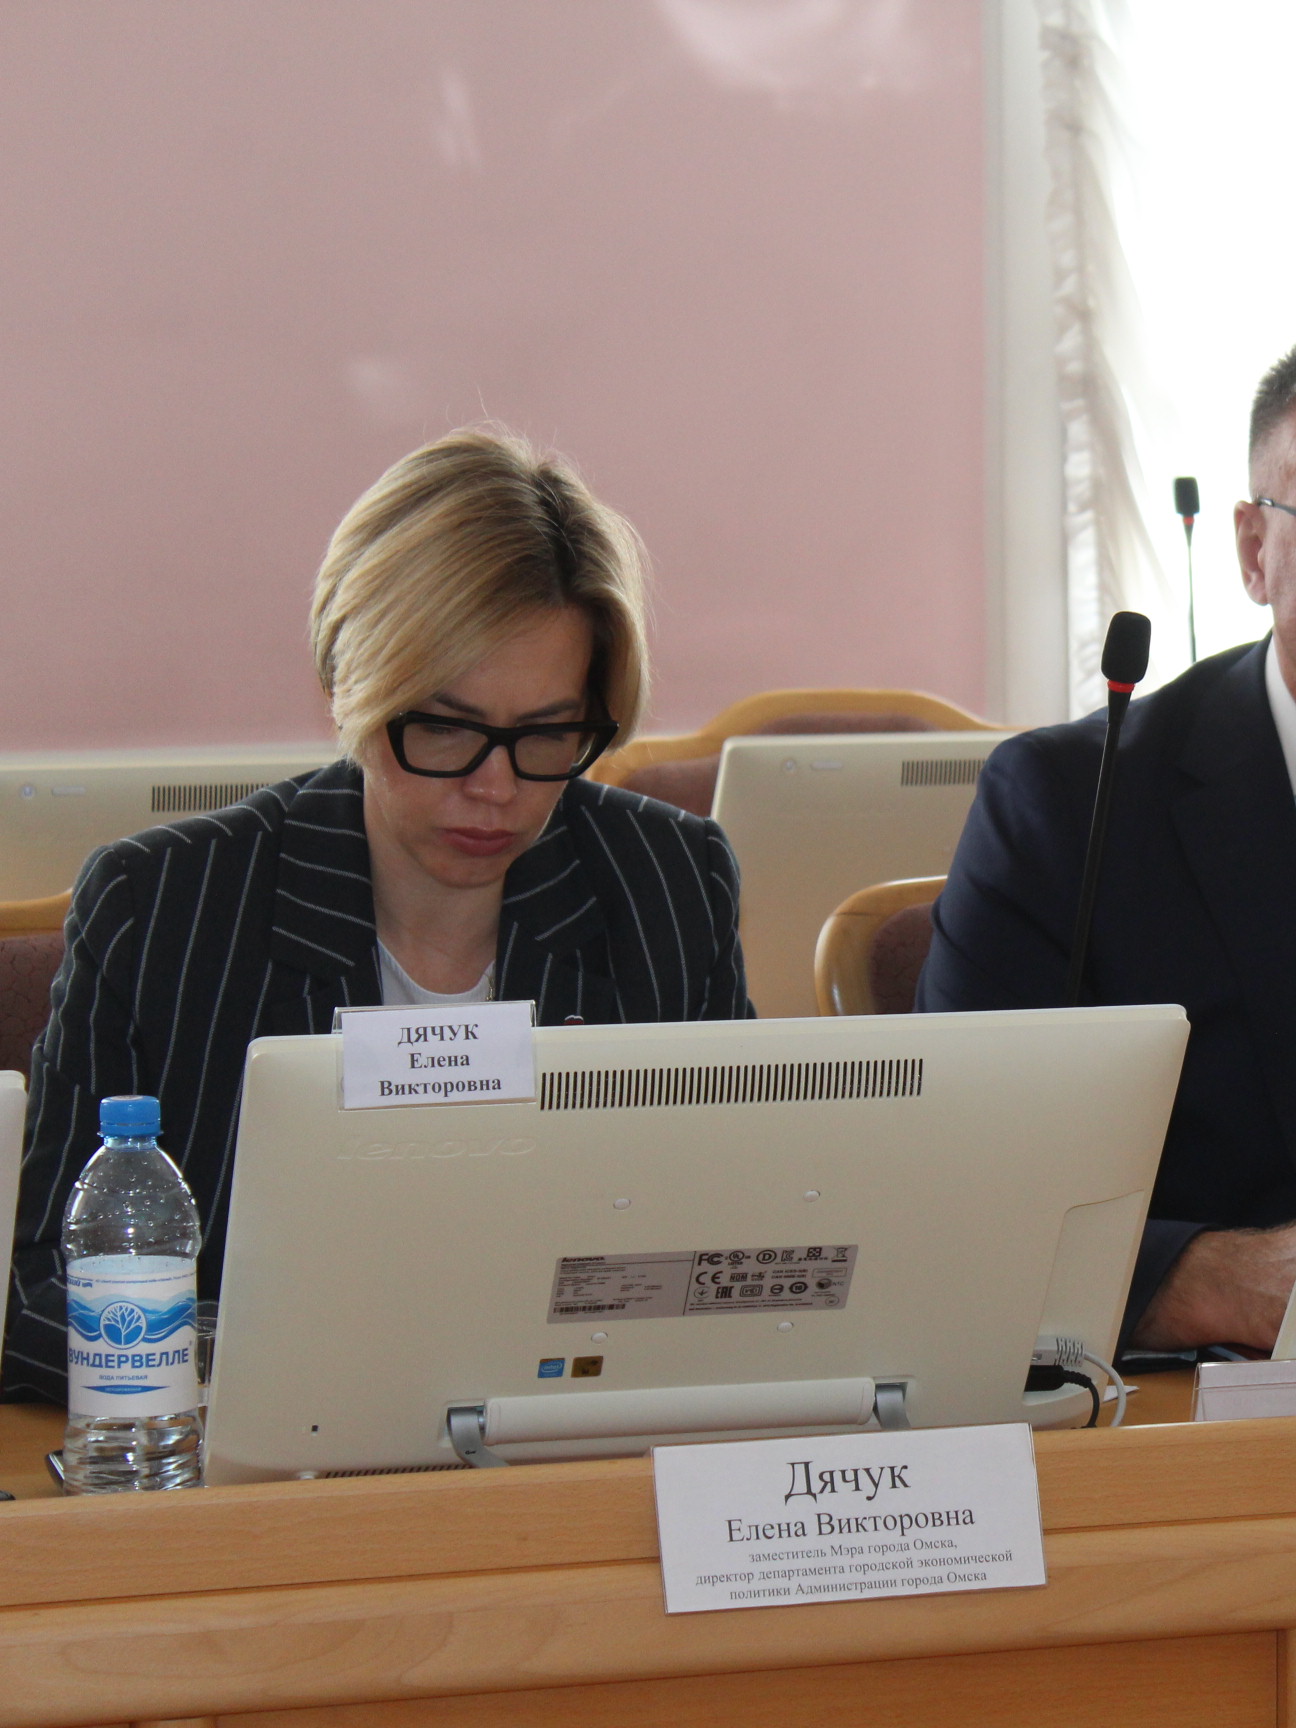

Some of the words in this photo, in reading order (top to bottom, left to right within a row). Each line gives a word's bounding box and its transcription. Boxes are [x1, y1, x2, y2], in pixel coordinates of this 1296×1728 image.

[397, 1023, 479, 1047] ДЯЧУК
[409, 1052, 470, 1069] Елена
[378, 1077, 502, 1097] Викторовна
[336, 1136, 536, 1160] lenovo
[68, 1348, 189, 1369] ВУНДЕРВЕЛЛЕ
[784, 1460, 911, 1505] Дячук
[725, 1517, 807, 1543] Елена
[815, 1508, 976, 1537] Викторовна
[749, 1548, 827, 1563] заместитель
[830, 1544, 864, 1558] Мэра
[868, 1542, 910, 1556] города
[913, 1538, 958, 1550] Омска,
[696, 1571, 754, 1586] директор
[758, 1565, 845, 1581] департамента
[849, 1557, 913, 1575] городской
[917, 1550, 1013, 1568] экономической
[730, 1586, 790, 1600] политики
[795, 1579, 897, 1595] Администрации
[901, 1574, 943, 1589] города
[947, 1571, 987, 1584] Омска
